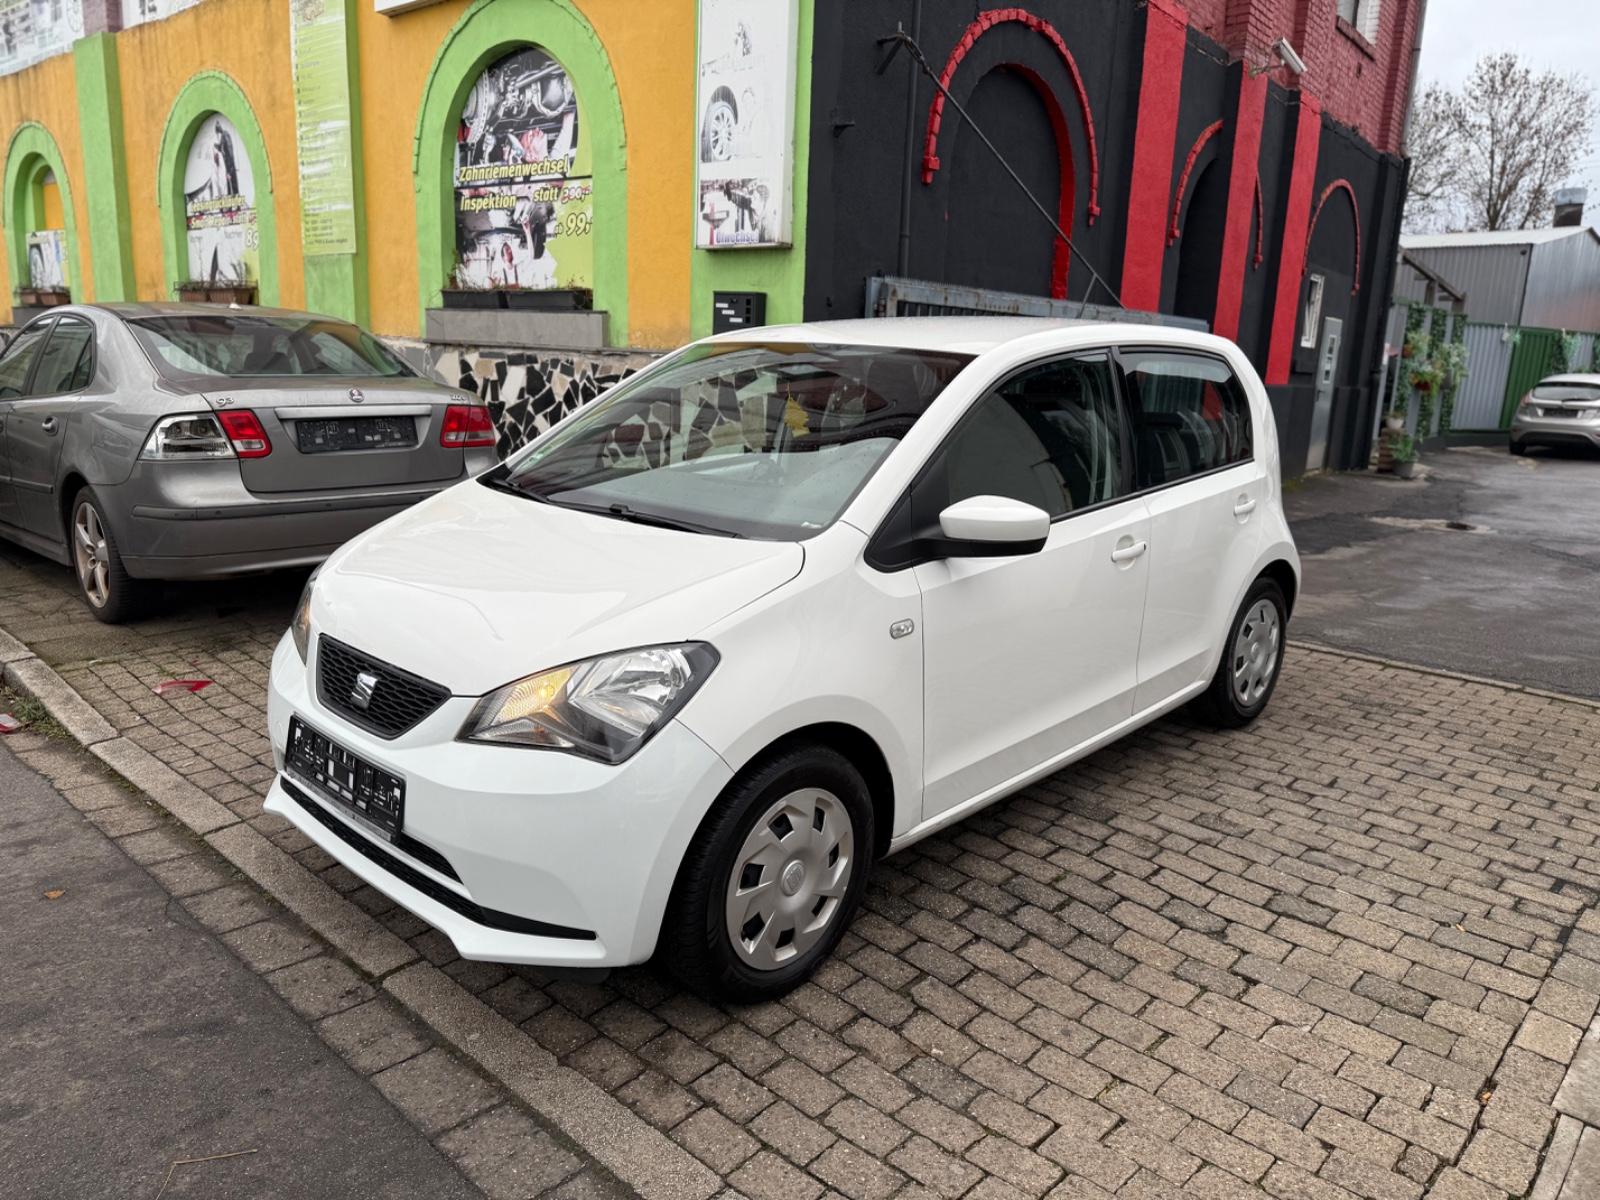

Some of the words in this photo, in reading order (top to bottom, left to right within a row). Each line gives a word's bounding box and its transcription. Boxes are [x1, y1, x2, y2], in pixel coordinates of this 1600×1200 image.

[459, 153, 569, 181] Zahnriemenwechsel
[460, 194, 517, 214] Inspektion
[533, 185, 559, 202] statt
